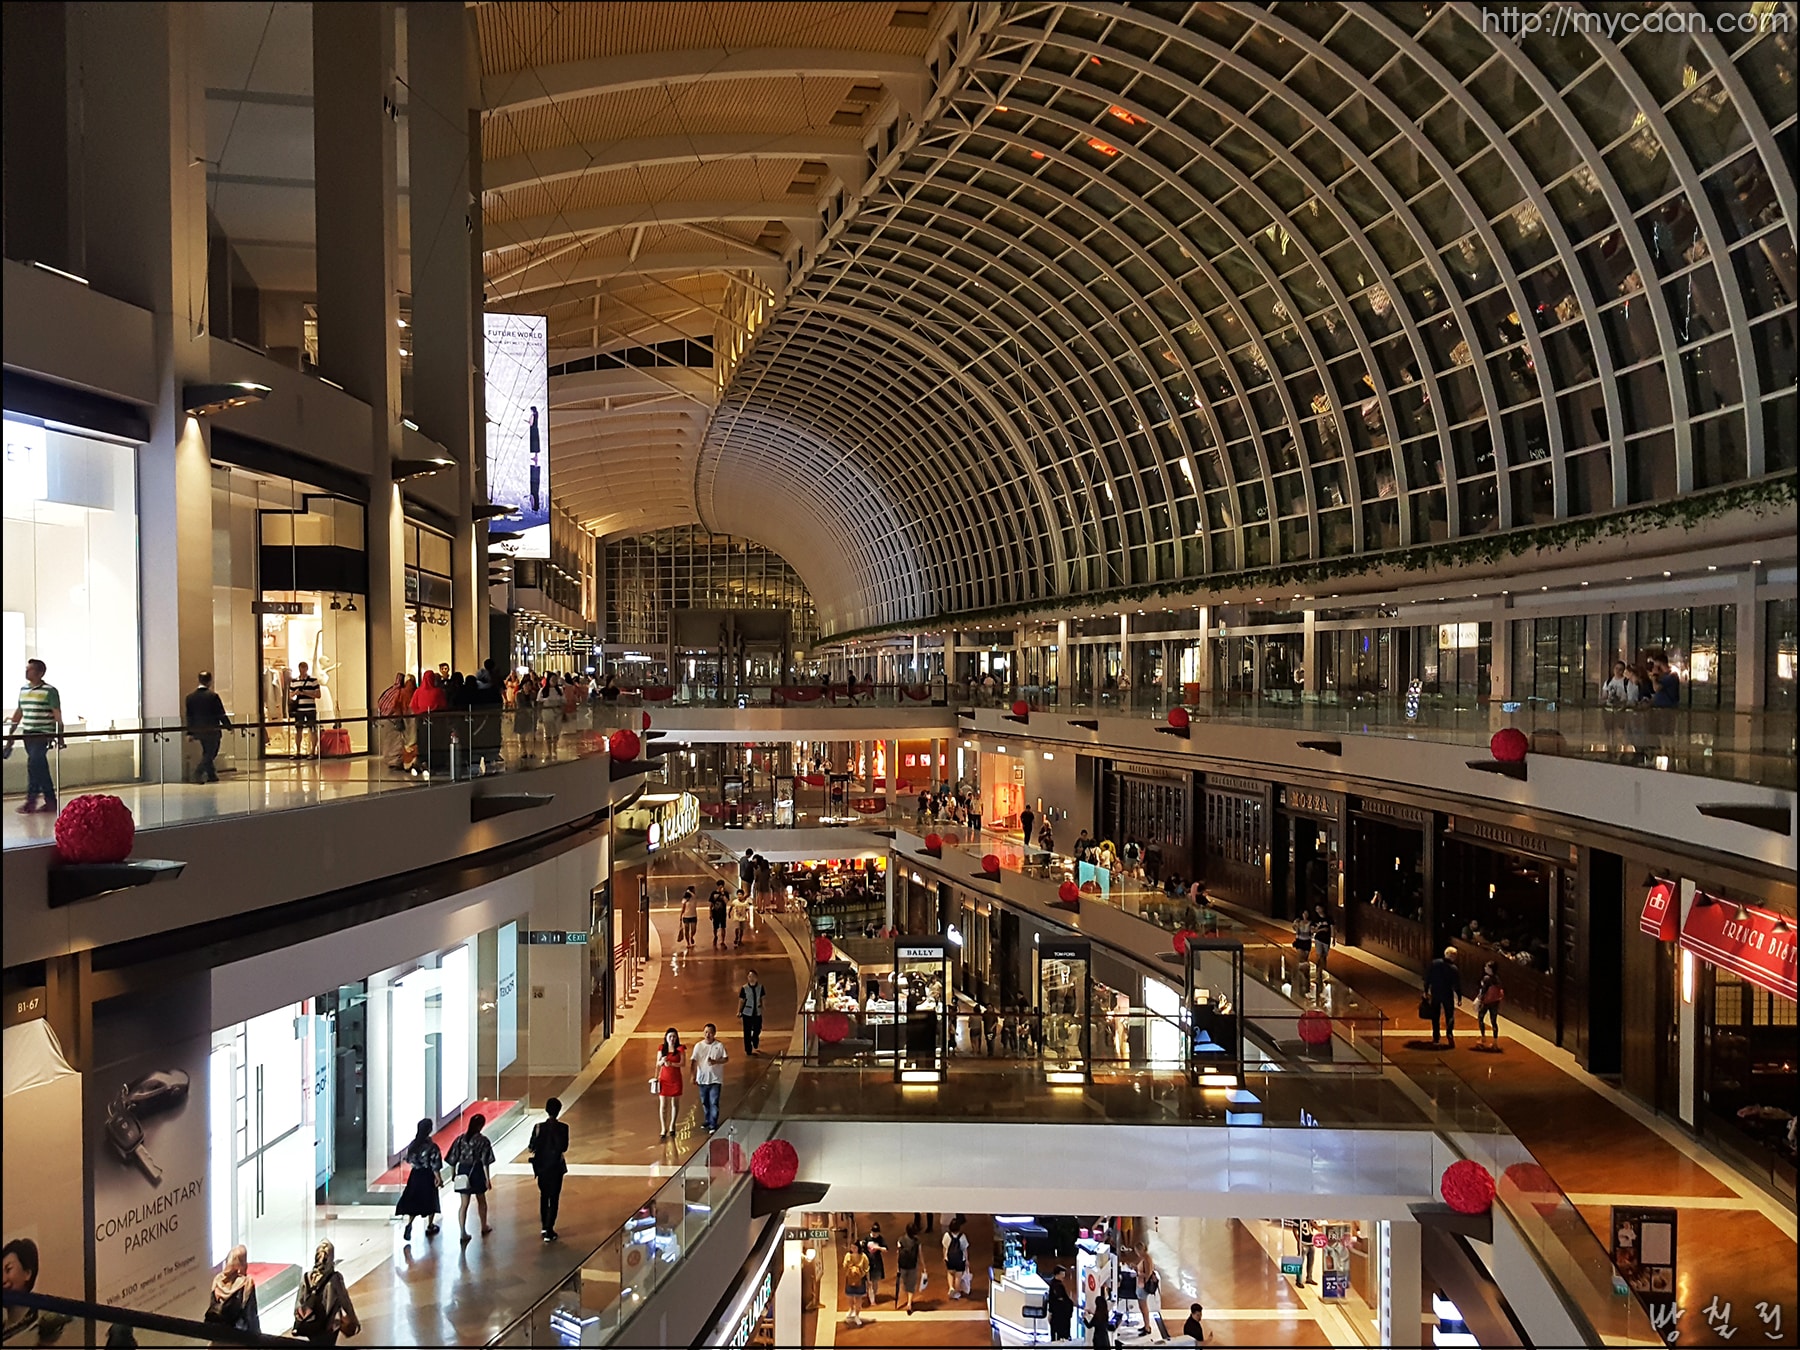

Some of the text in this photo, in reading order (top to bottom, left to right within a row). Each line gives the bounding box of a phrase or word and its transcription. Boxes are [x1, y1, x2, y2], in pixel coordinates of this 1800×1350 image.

[488, 329, 543, 339] FUTURE WORLD
[1291, 791, 1329, 813] MOZZA
[572, 934, 586, 942] EXIT
[1767, 937, 1797, 965] BIST
[96, 1177, 204, 1242] COMPLIMENTARY
[125, 1214, 178, 1254] PARKING
[815, 1230, 827, 1238] EXIT
[1286, 1265, 1300, 1273] EXIT
[121, 1283, 138, 1299] $100
[163, 1266, 174, 1276] The
